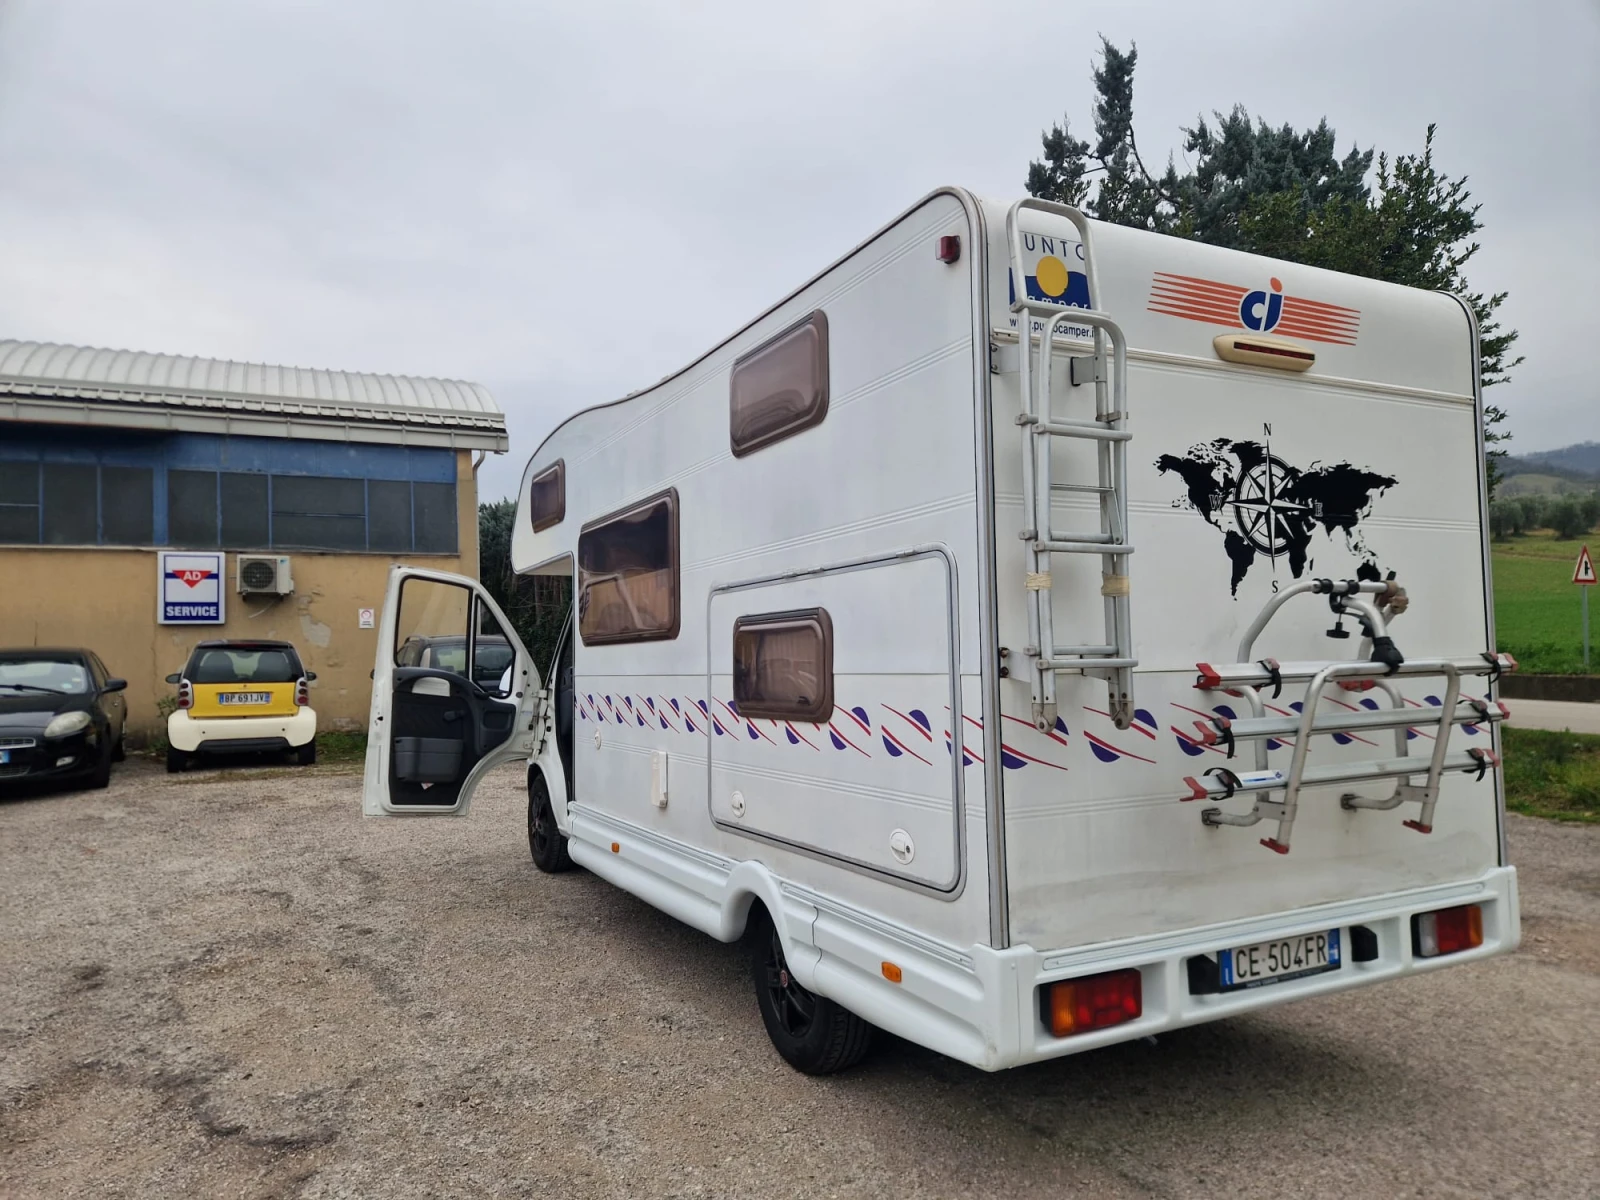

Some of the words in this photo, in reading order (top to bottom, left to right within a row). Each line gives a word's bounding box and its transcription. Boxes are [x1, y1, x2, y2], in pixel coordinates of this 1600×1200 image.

[1023, 232, 1086, 261] UNTO
[1009, 317, 1095, 339] w.puocamper.i
[1263, 422, 1272, 436] N
[1208, 494, 1222, 510] W
[1315, 502, 1323, 517] E
[183, 571, 202, 581] AD
[1271, 580, 1279, 594] S
[166, 606, 217, 617] SERVICE
[1236, 946, 1261, 979] CE
[1268, 934, 1327, 973] 504FR
